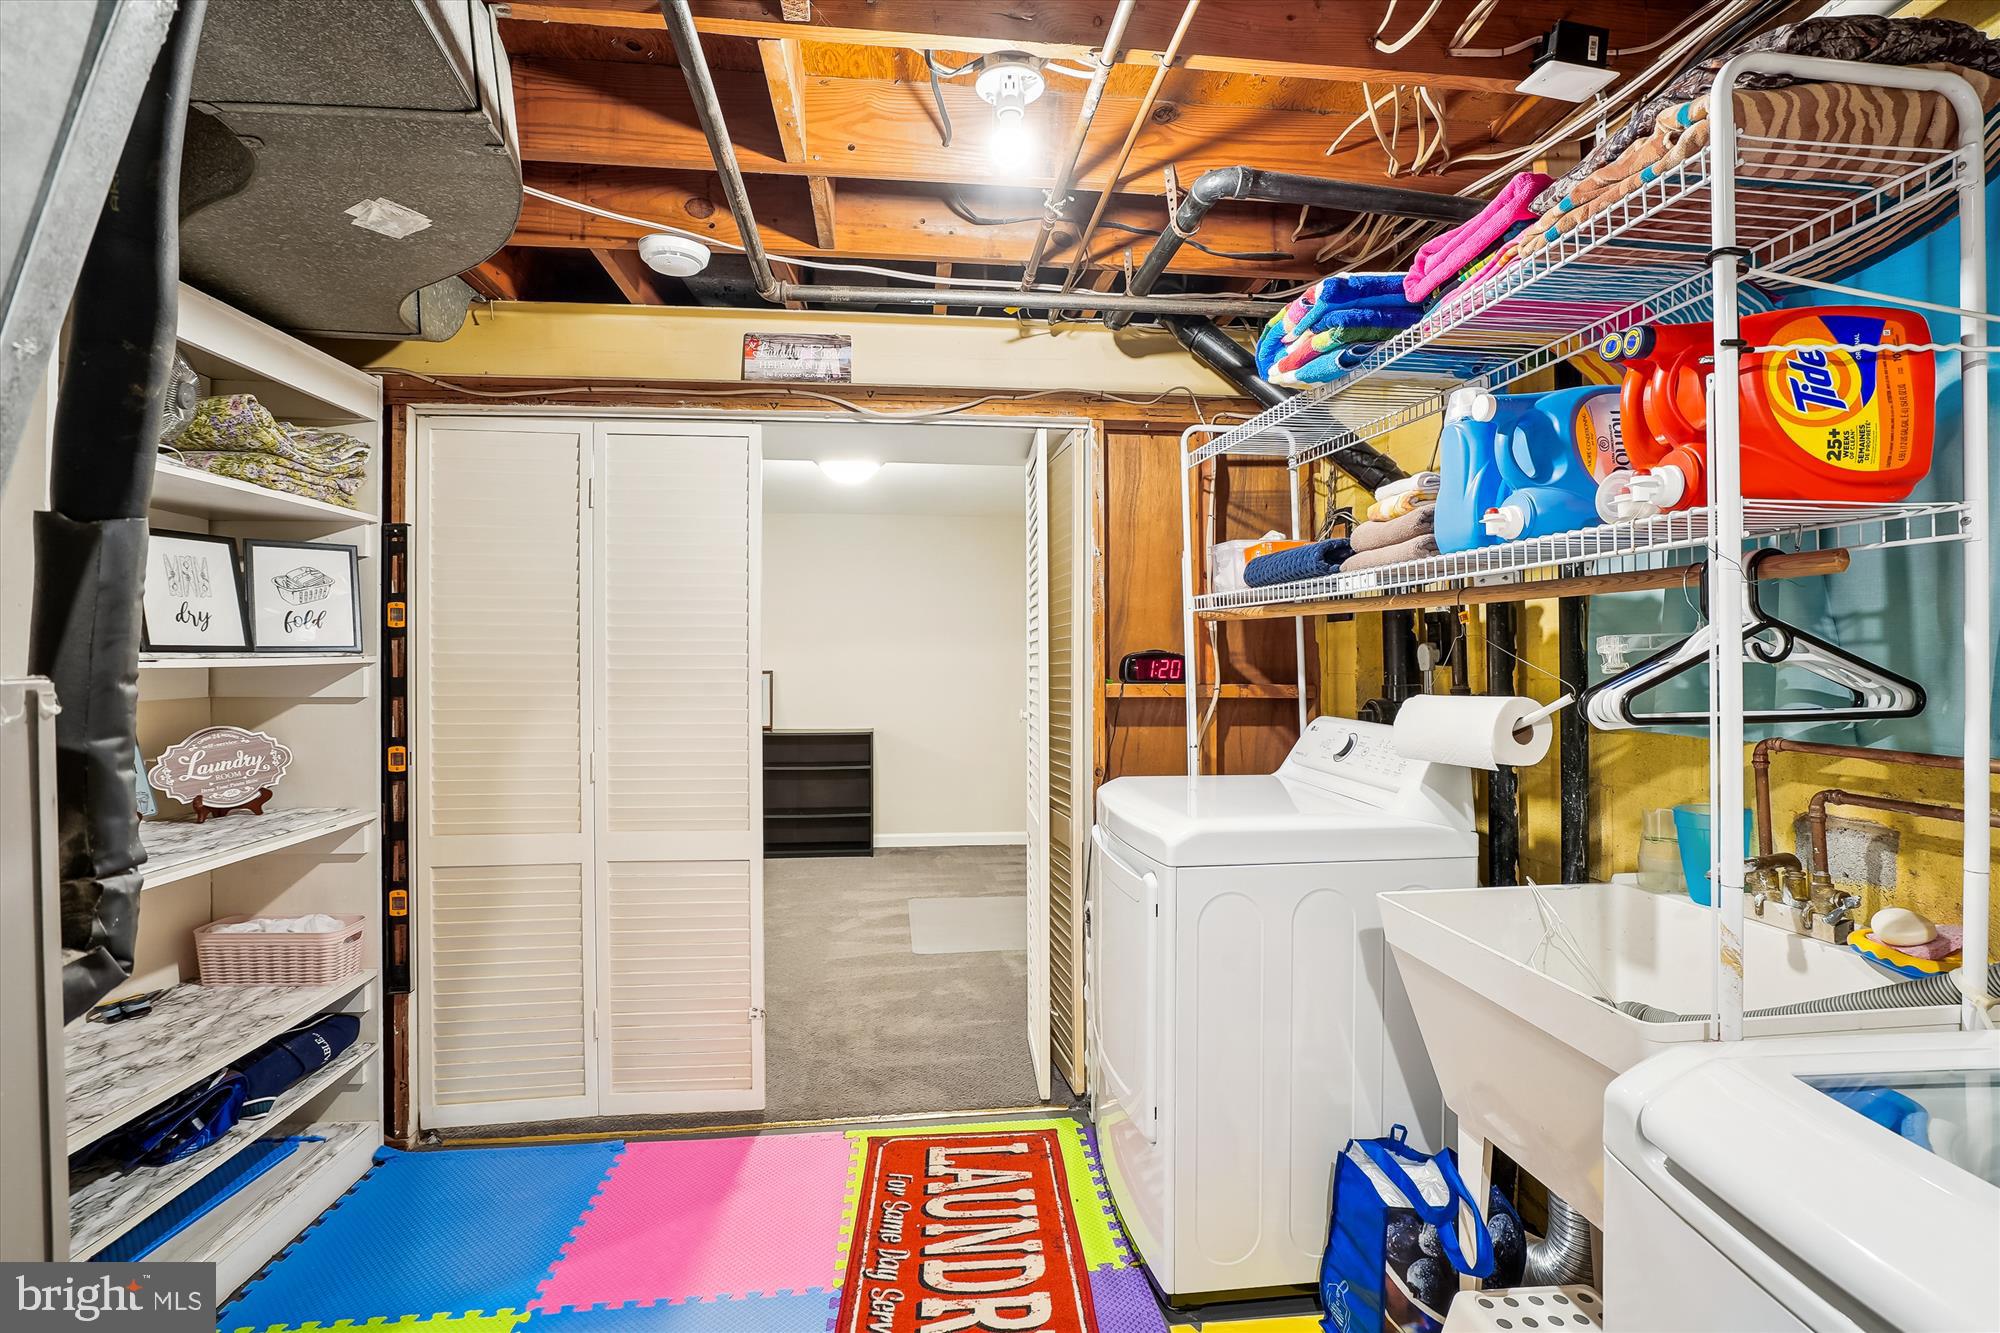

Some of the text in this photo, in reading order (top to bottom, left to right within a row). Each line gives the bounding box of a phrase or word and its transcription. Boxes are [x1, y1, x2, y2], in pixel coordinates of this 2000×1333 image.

[1854, 333, 1862, 360] ORNAL
[1786, 349, 1850, 413] Tide
[1826, 428, 1843, 462] 25+
[1850, 451, 1855, 460] OF
[1857, 424, 1866, 464] SEMAINES
[175, 601, 212, 632] dry
[284, 610, 327, 634] fold
[1150, 660, 1181, 679] 1:20
[178, 750, 270, 782] Laundry
[215, 770, 242, 781] ROOM
[886, 1173, 913, 1197] For
[878, 1200, 912, 1243] Same
[920, 1142, 1056, 1333] LAUNDR
[863, 1248, 911, 1281] Day
